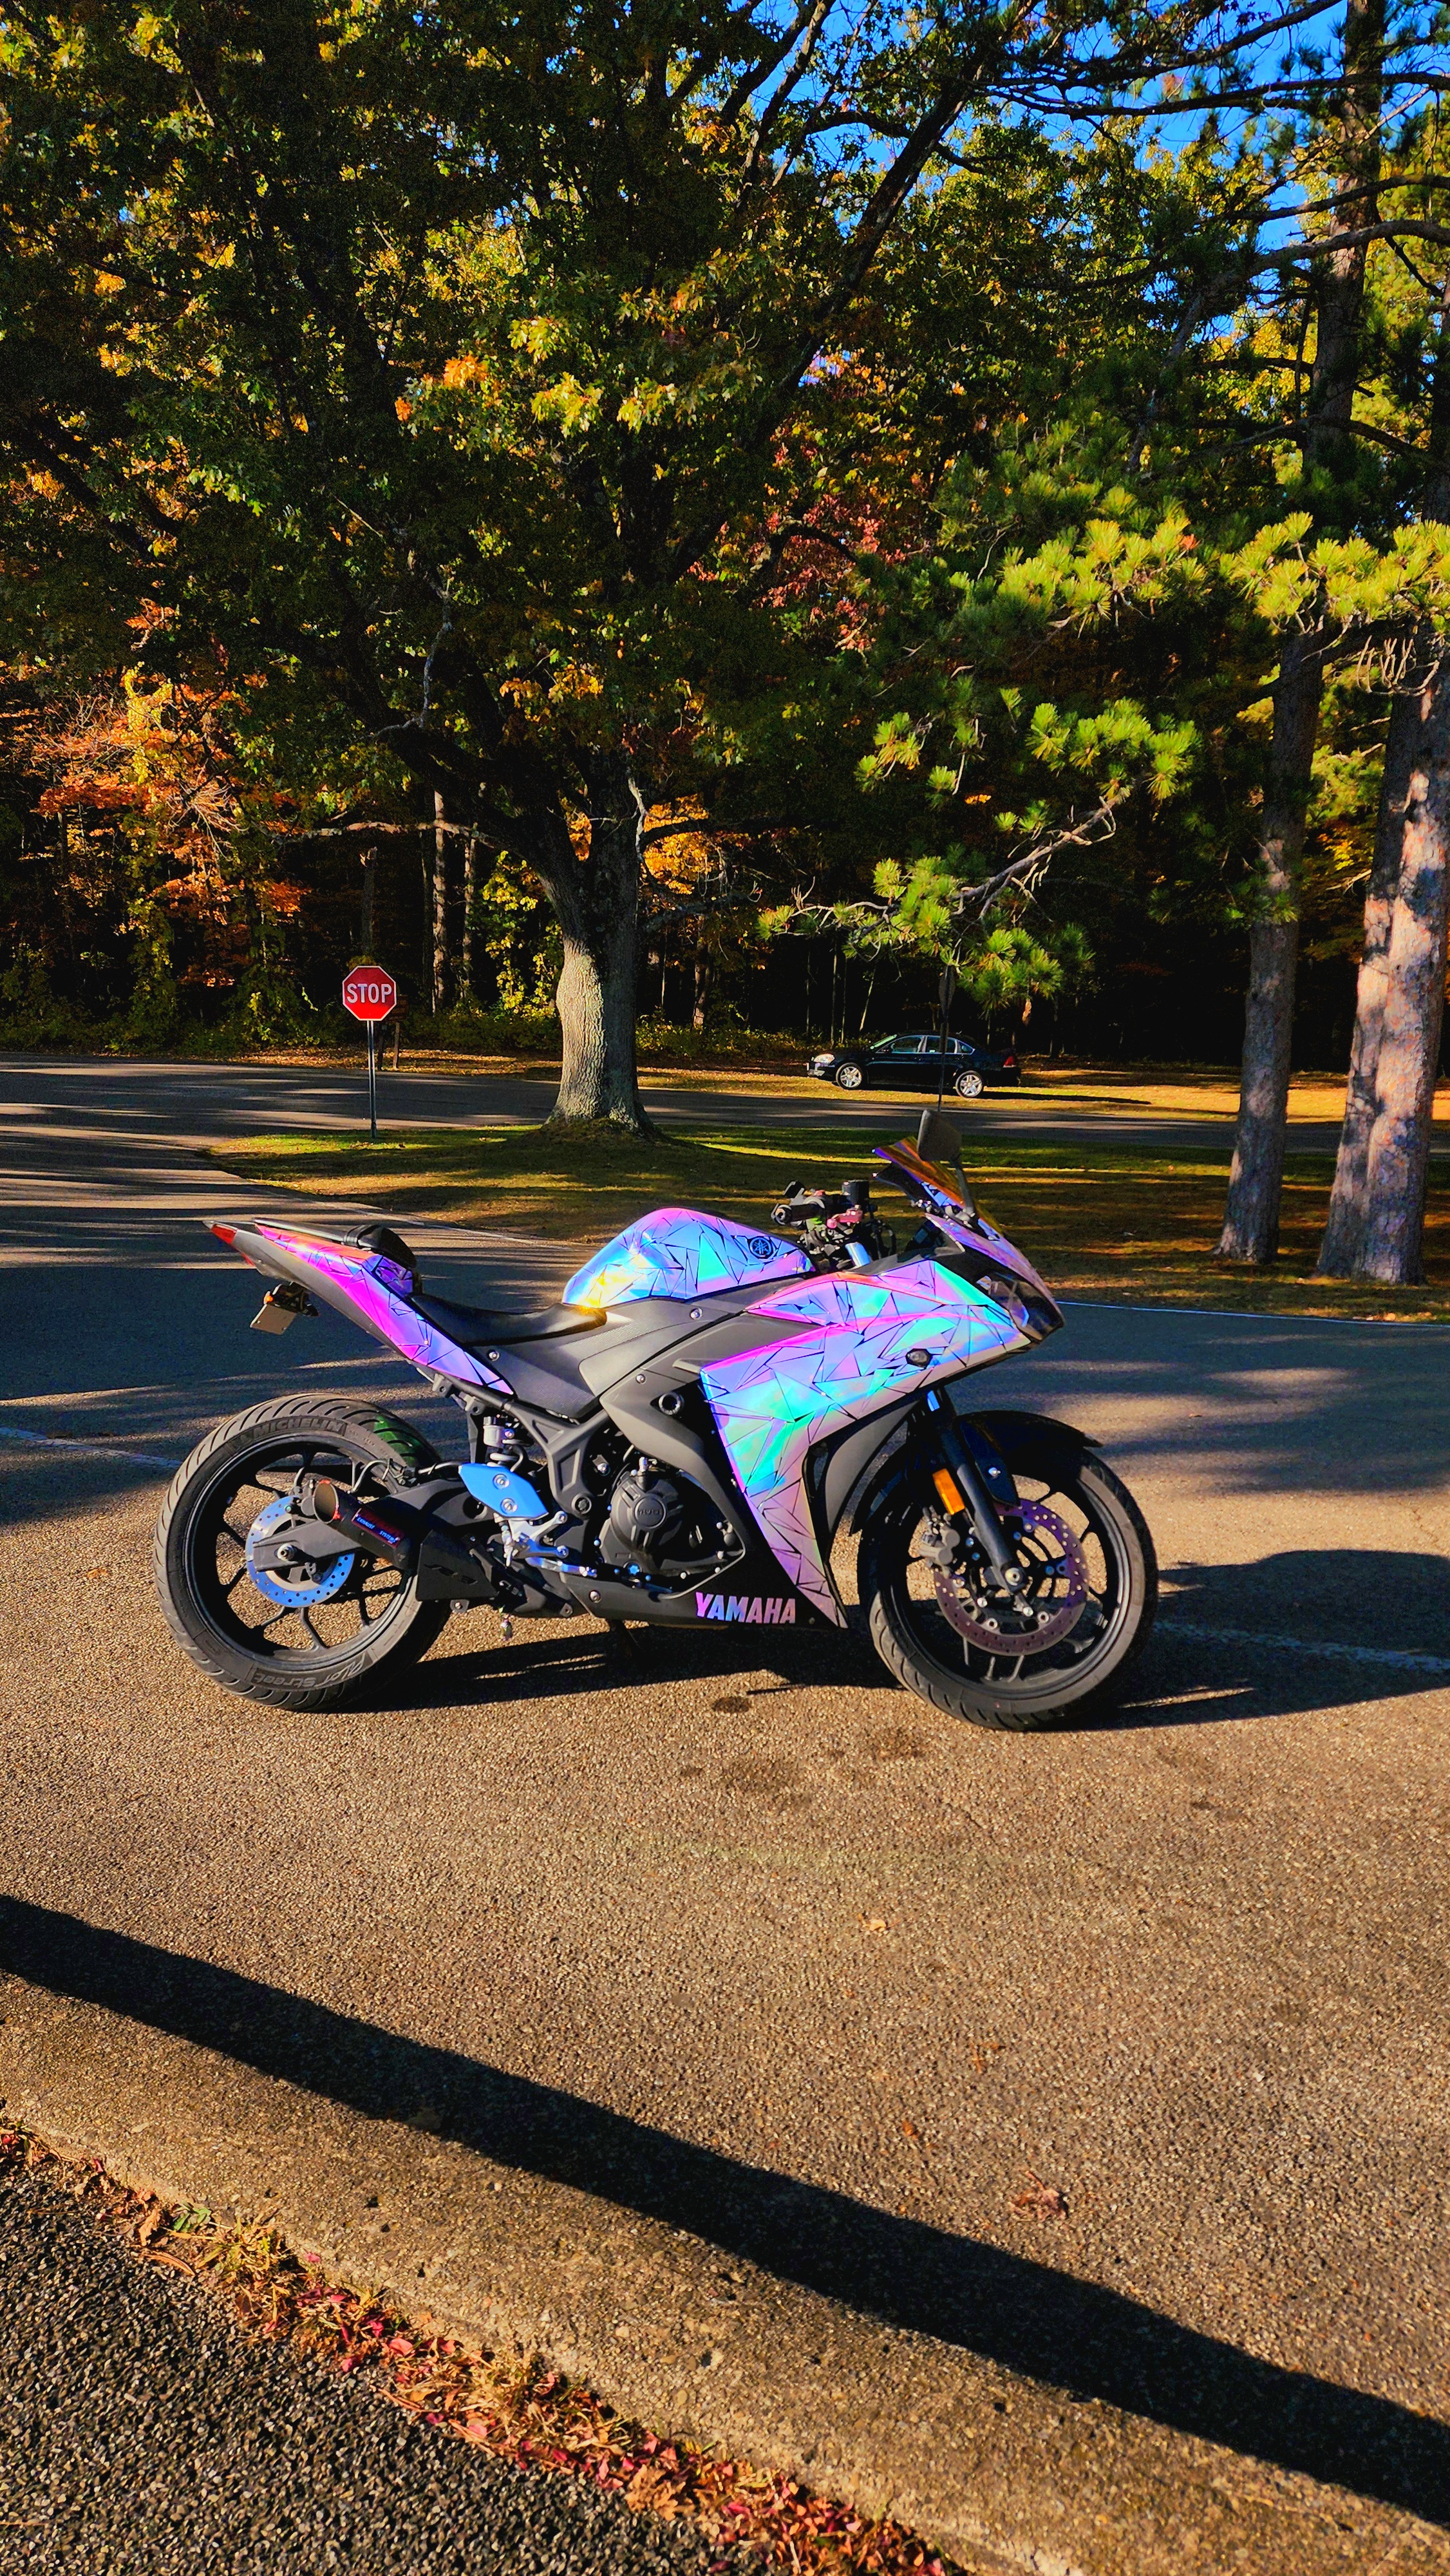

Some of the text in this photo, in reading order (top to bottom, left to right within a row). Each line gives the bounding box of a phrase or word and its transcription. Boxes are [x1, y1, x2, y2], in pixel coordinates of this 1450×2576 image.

[347, 983, 392, 1003] STOP
[253, 1418, 343, 1438] MICHELIN
[695, 1591, 796, 1624] YAMAHA
